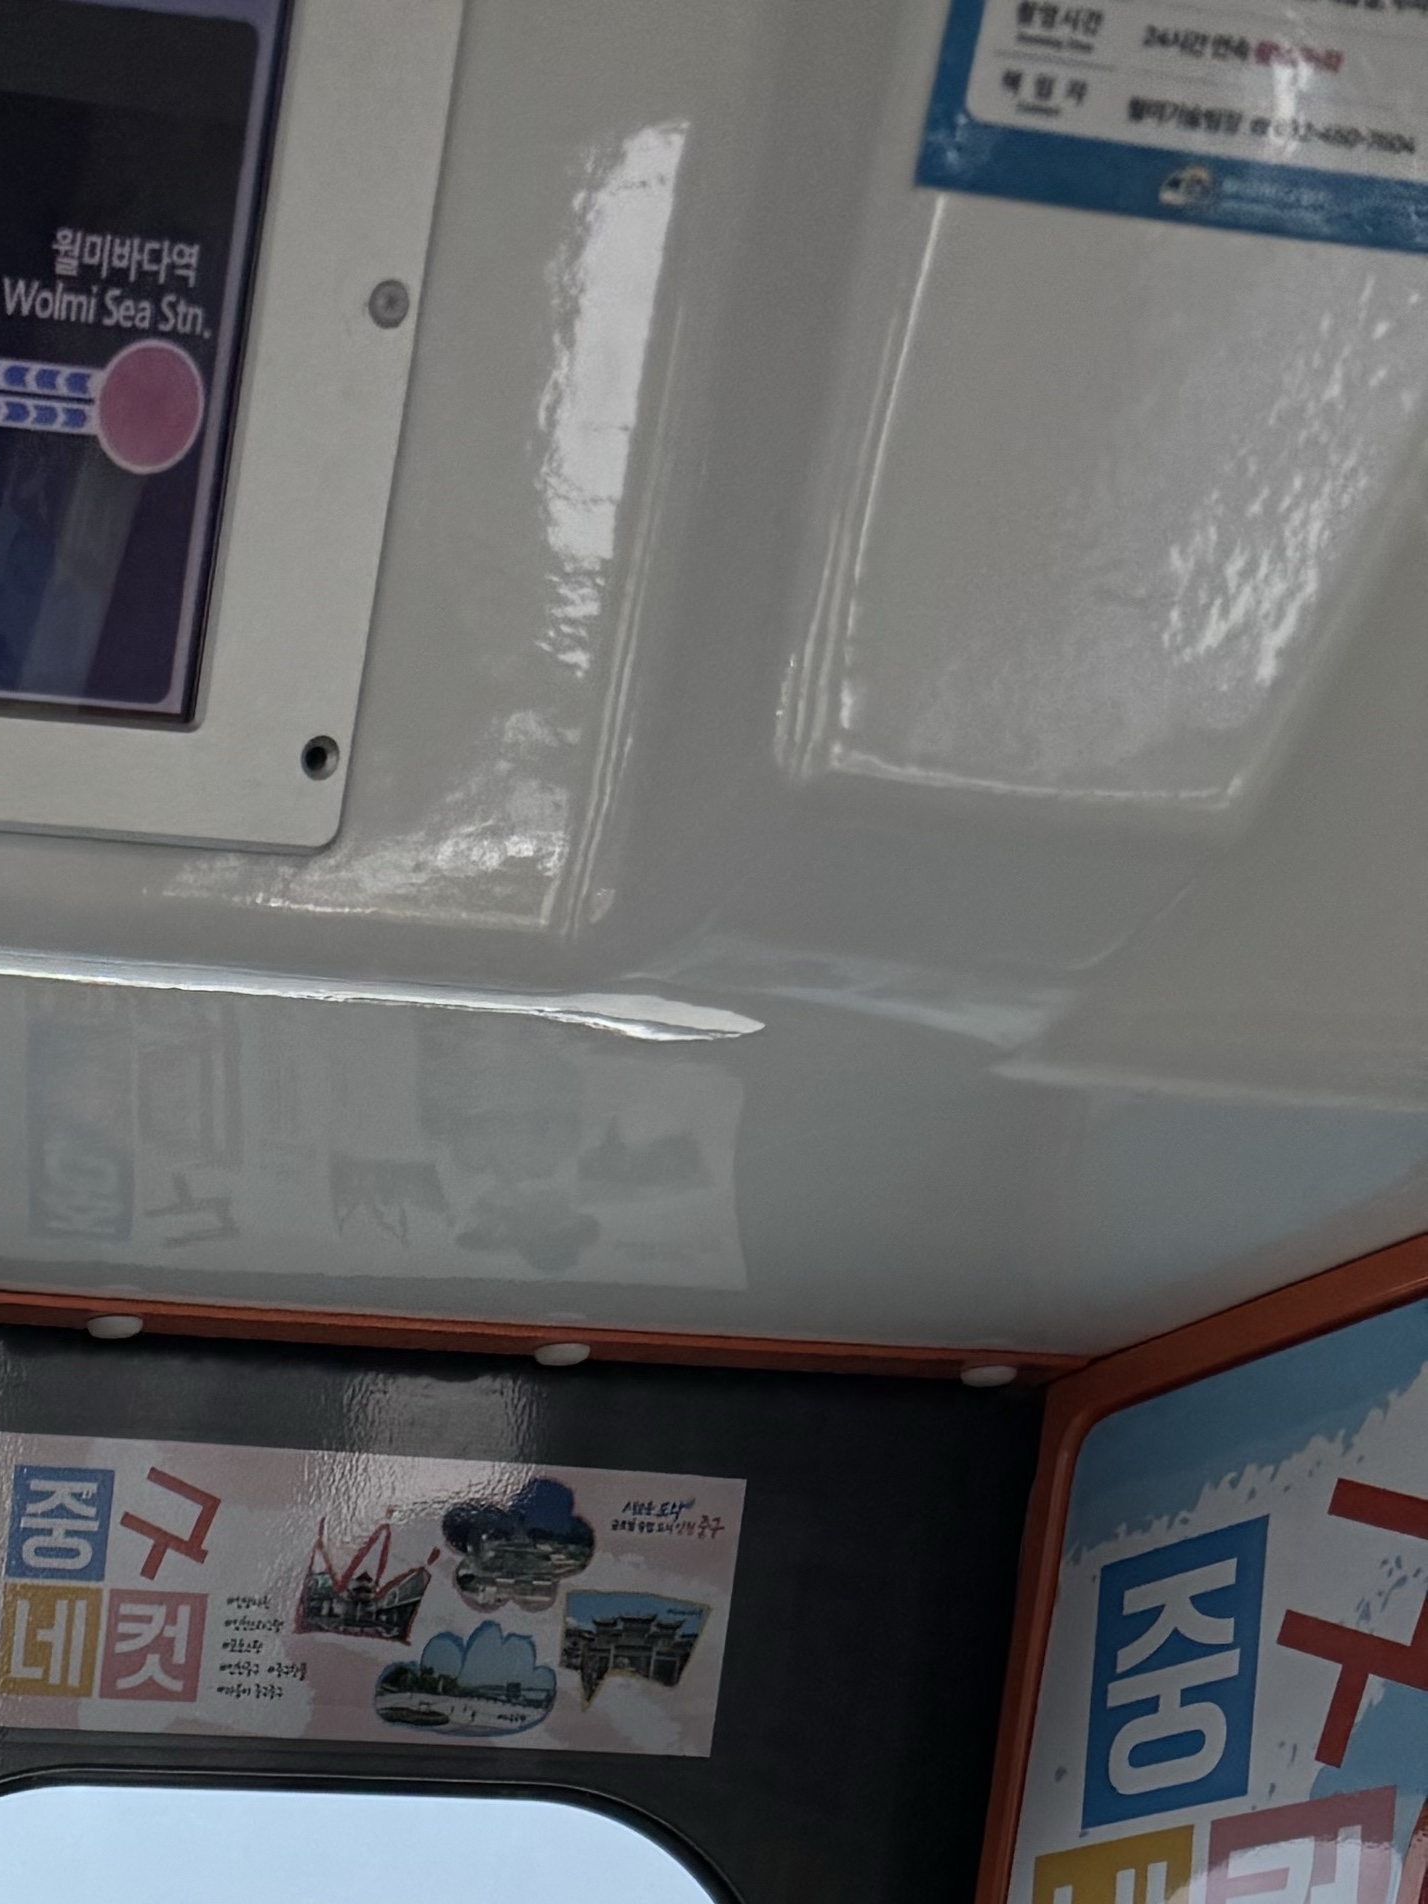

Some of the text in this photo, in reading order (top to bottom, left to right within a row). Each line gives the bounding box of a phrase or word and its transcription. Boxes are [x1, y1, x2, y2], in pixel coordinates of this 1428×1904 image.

[52, 226, 200, 288] 월미바다역
[2, 276, 212, 340] Wolmi Sea Stn.
[18, 1467, 221, 1580] 중구
[697, 1515, 725, 1539] 중구
[10, 1594, 188, 1693] 네컷
